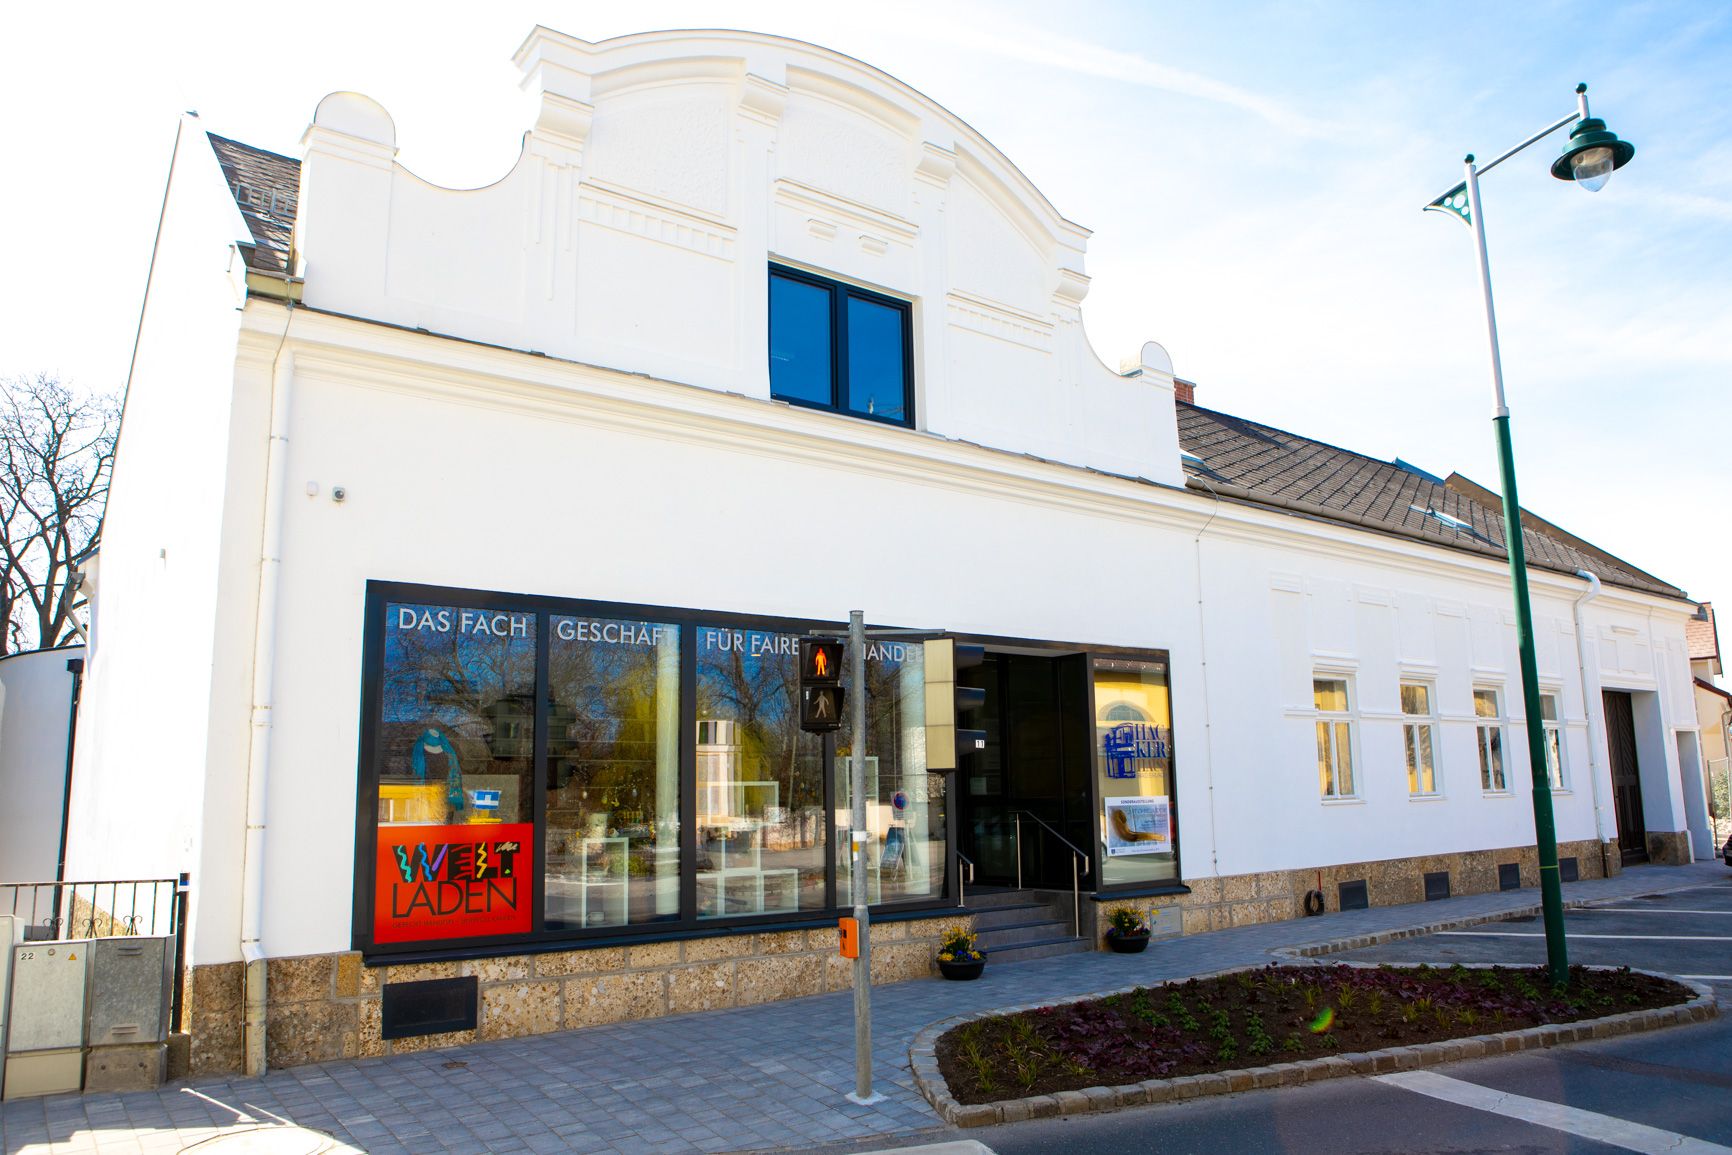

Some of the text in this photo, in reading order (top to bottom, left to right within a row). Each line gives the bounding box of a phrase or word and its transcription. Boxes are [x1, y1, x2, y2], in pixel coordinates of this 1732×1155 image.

[399, 608, 451, 633] DAS
[461, 612, 527, 637] FACH
[706, 628, 745, 653] FÜR
[751, 635, 799, 656] FAIRE
[976, 740, 984, 748] 11
[1136, 741, 1167, 758] KER
[391, 841, 521, 882] WELT
[392, 877, 517, 918] LADEN
[21, 952, 34, 961] 22
